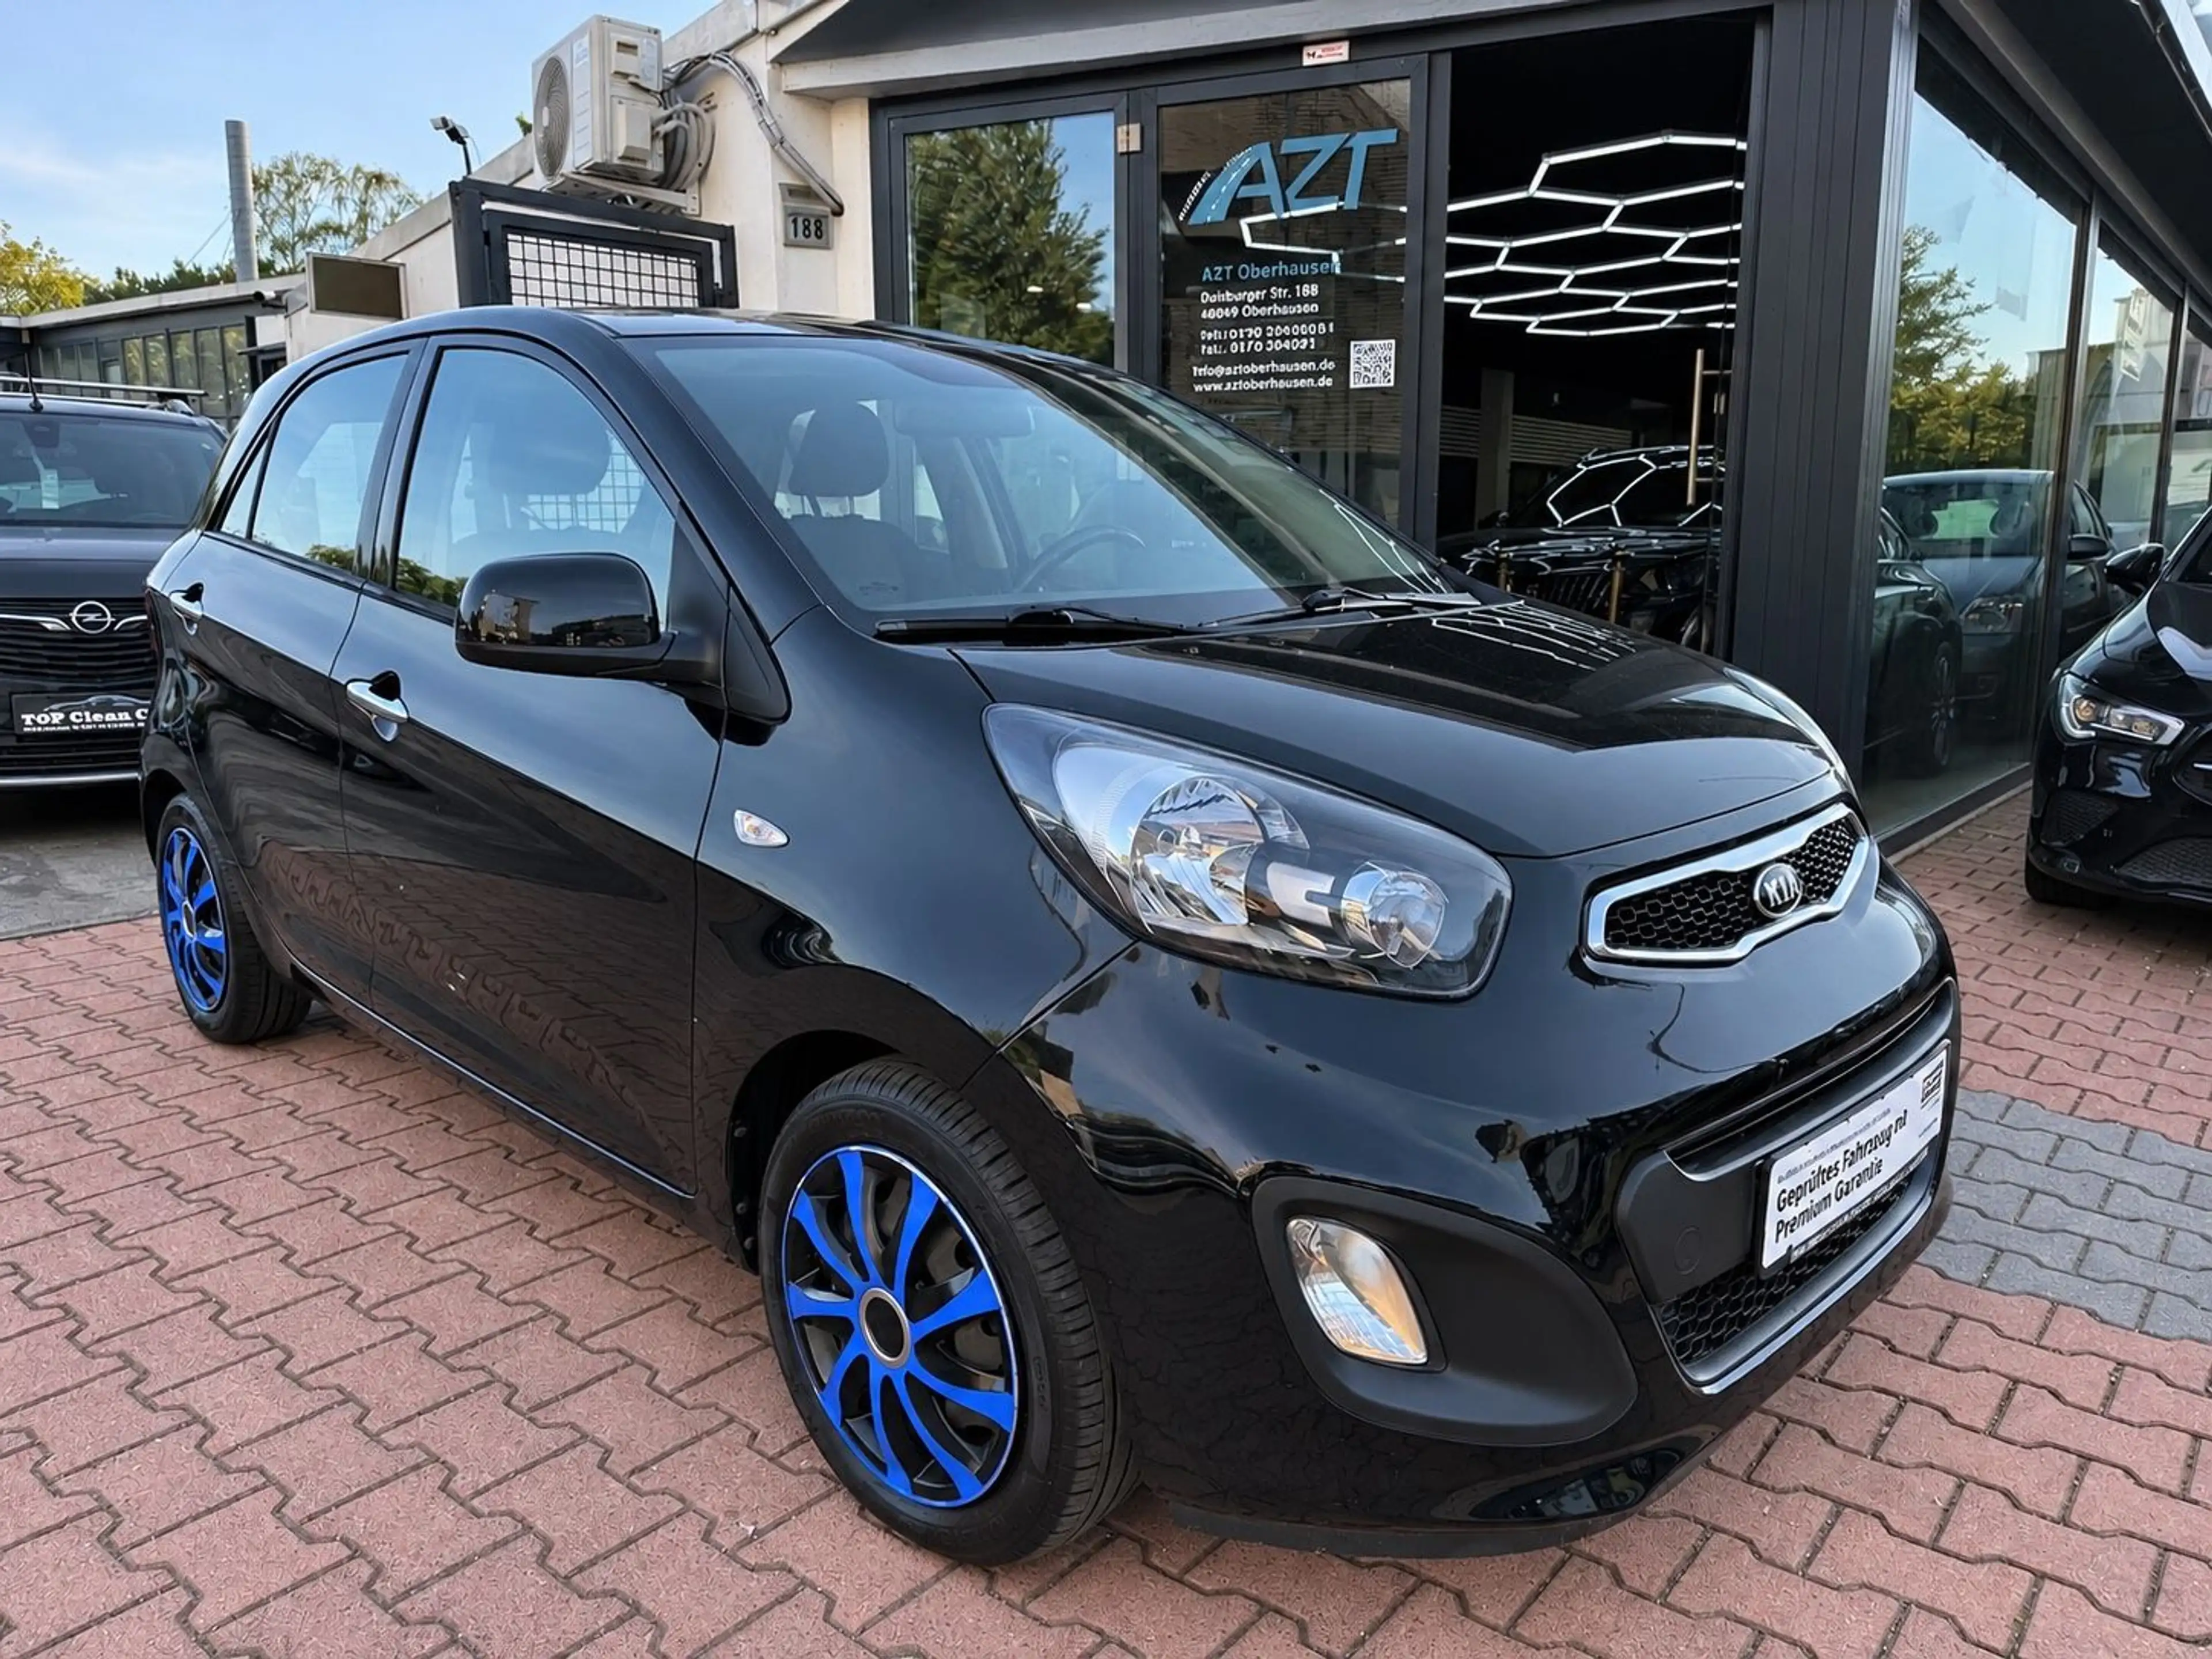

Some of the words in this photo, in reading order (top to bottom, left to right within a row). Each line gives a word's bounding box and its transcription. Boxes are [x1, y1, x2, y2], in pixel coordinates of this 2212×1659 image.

[1188, 128, 1398, 226] AZT
[791, 217, 823, 240] 188
[1202, 265, 1233, 282] AZT
[1238, 261, 1341, 279] Oberhausen
[1270, 286, 1292, 300] Str.
[21, 712, 65, 725] TOP
[69, 710, 132, 723] Clean
[1777, 1160, 1840, 1213] Geprüftes
[1834, 1157, 1884, 1202] Garantie
